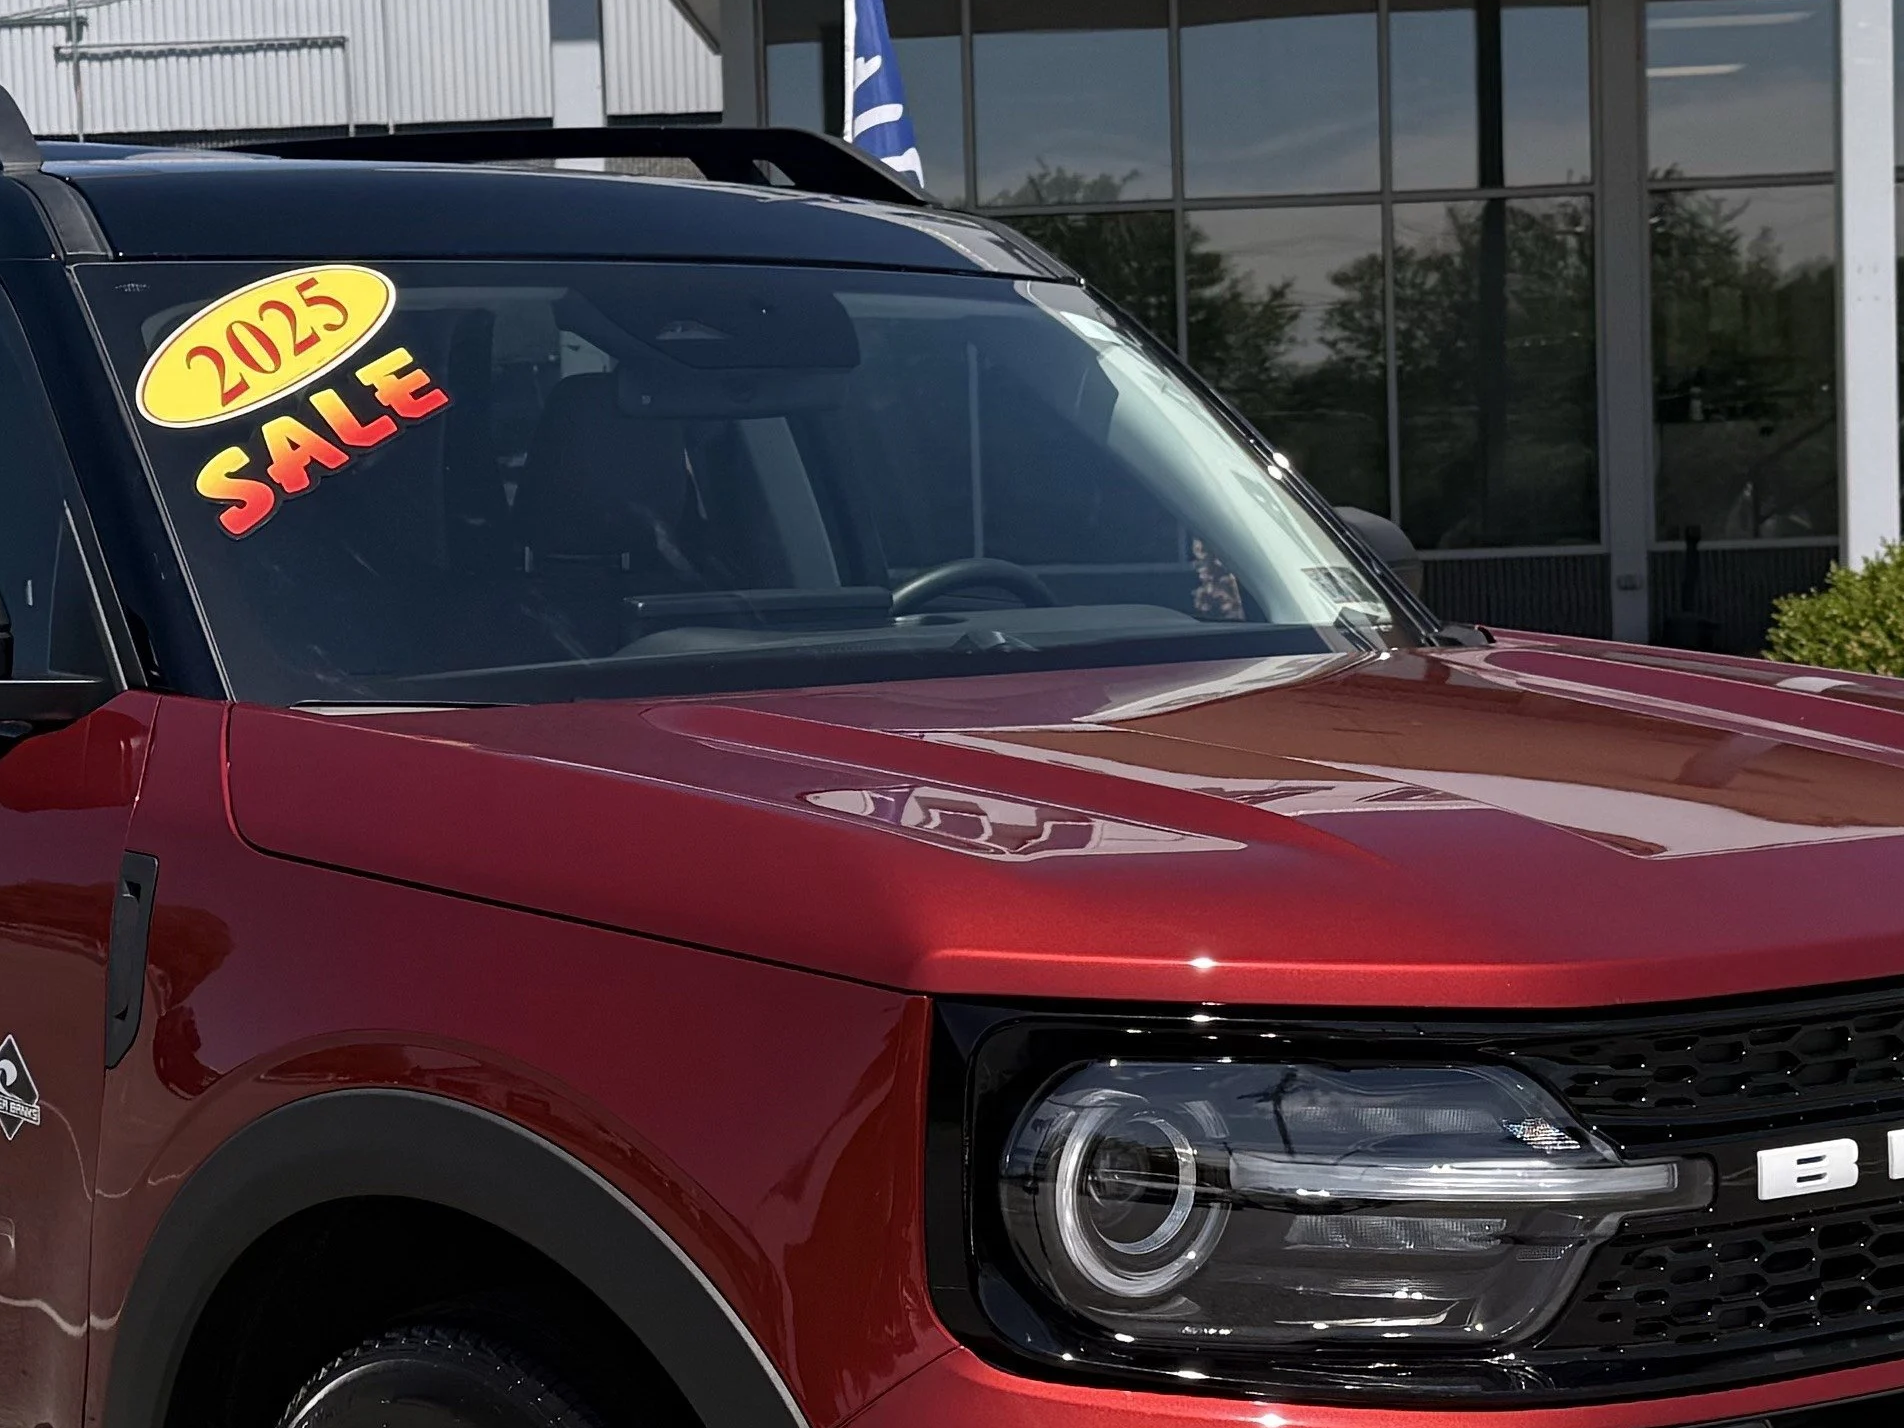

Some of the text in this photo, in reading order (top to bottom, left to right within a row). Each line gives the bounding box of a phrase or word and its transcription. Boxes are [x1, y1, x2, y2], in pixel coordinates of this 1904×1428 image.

[185, 276, 349, 408] 2025
[195, 347, 450, 537] SALE
[9, 1102, 39, 1121] BANKS
